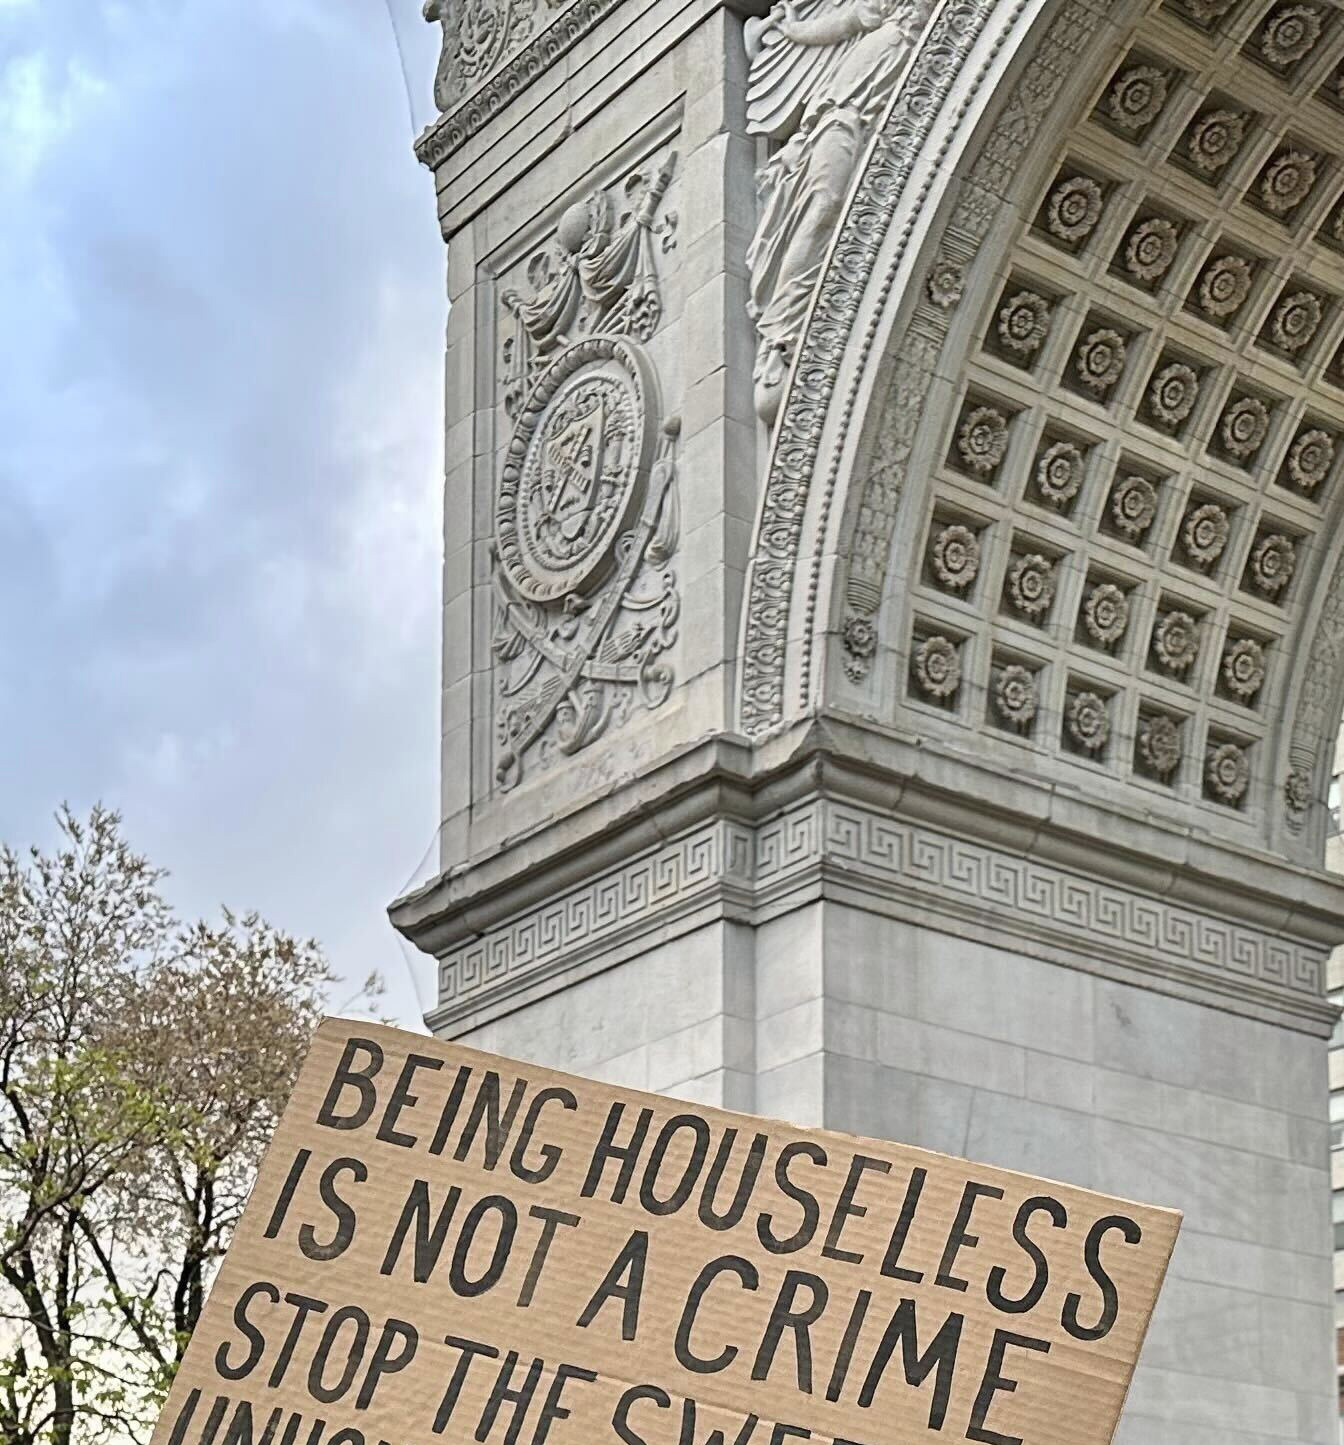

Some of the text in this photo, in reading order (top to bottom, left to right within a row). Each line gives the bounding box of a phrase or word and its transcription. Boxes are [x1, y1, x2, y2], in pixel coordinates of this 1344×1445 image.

[263, 1148, 369, 1261] IS
[379, 1179, 582, 1308] NOT
[575, 1229, 650, 1342] A
[315, 1037, 1142, 1341] BEING HOUSELESS
[215, 1281, 419, 1410] STOP
